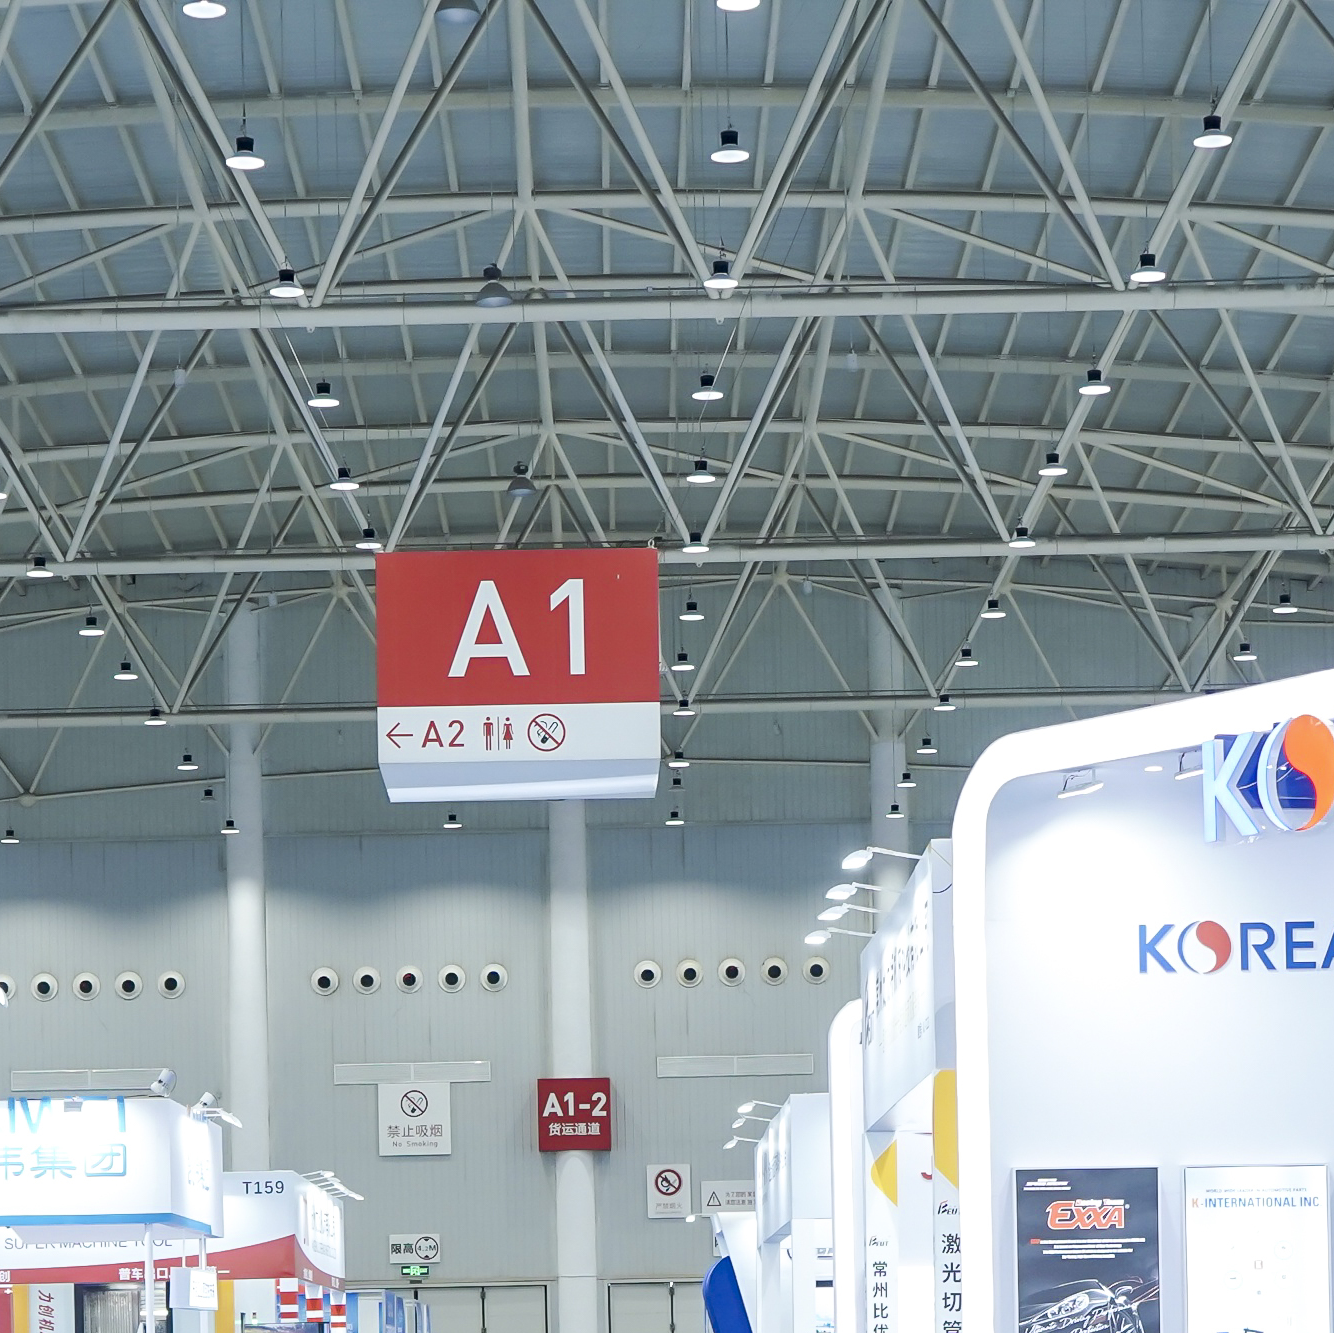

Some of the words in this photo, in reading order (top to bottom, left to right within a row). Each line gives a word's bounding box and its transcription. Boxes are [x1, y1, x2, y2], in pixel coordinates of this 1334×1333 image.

[447, 578, 588, 678] A1
[421, 719, 465, 750] A2
[541, 1091, 607, 1118] A1-2
[386, 1123, 443, 1138] 禁止吸烟
[547, 1121, 602, 1137] 货运通道
[391, 1140, 403, 1148] No
[406, 1140, 439, 1149] Smoking
[242, 1180, 285, 1195] T159
